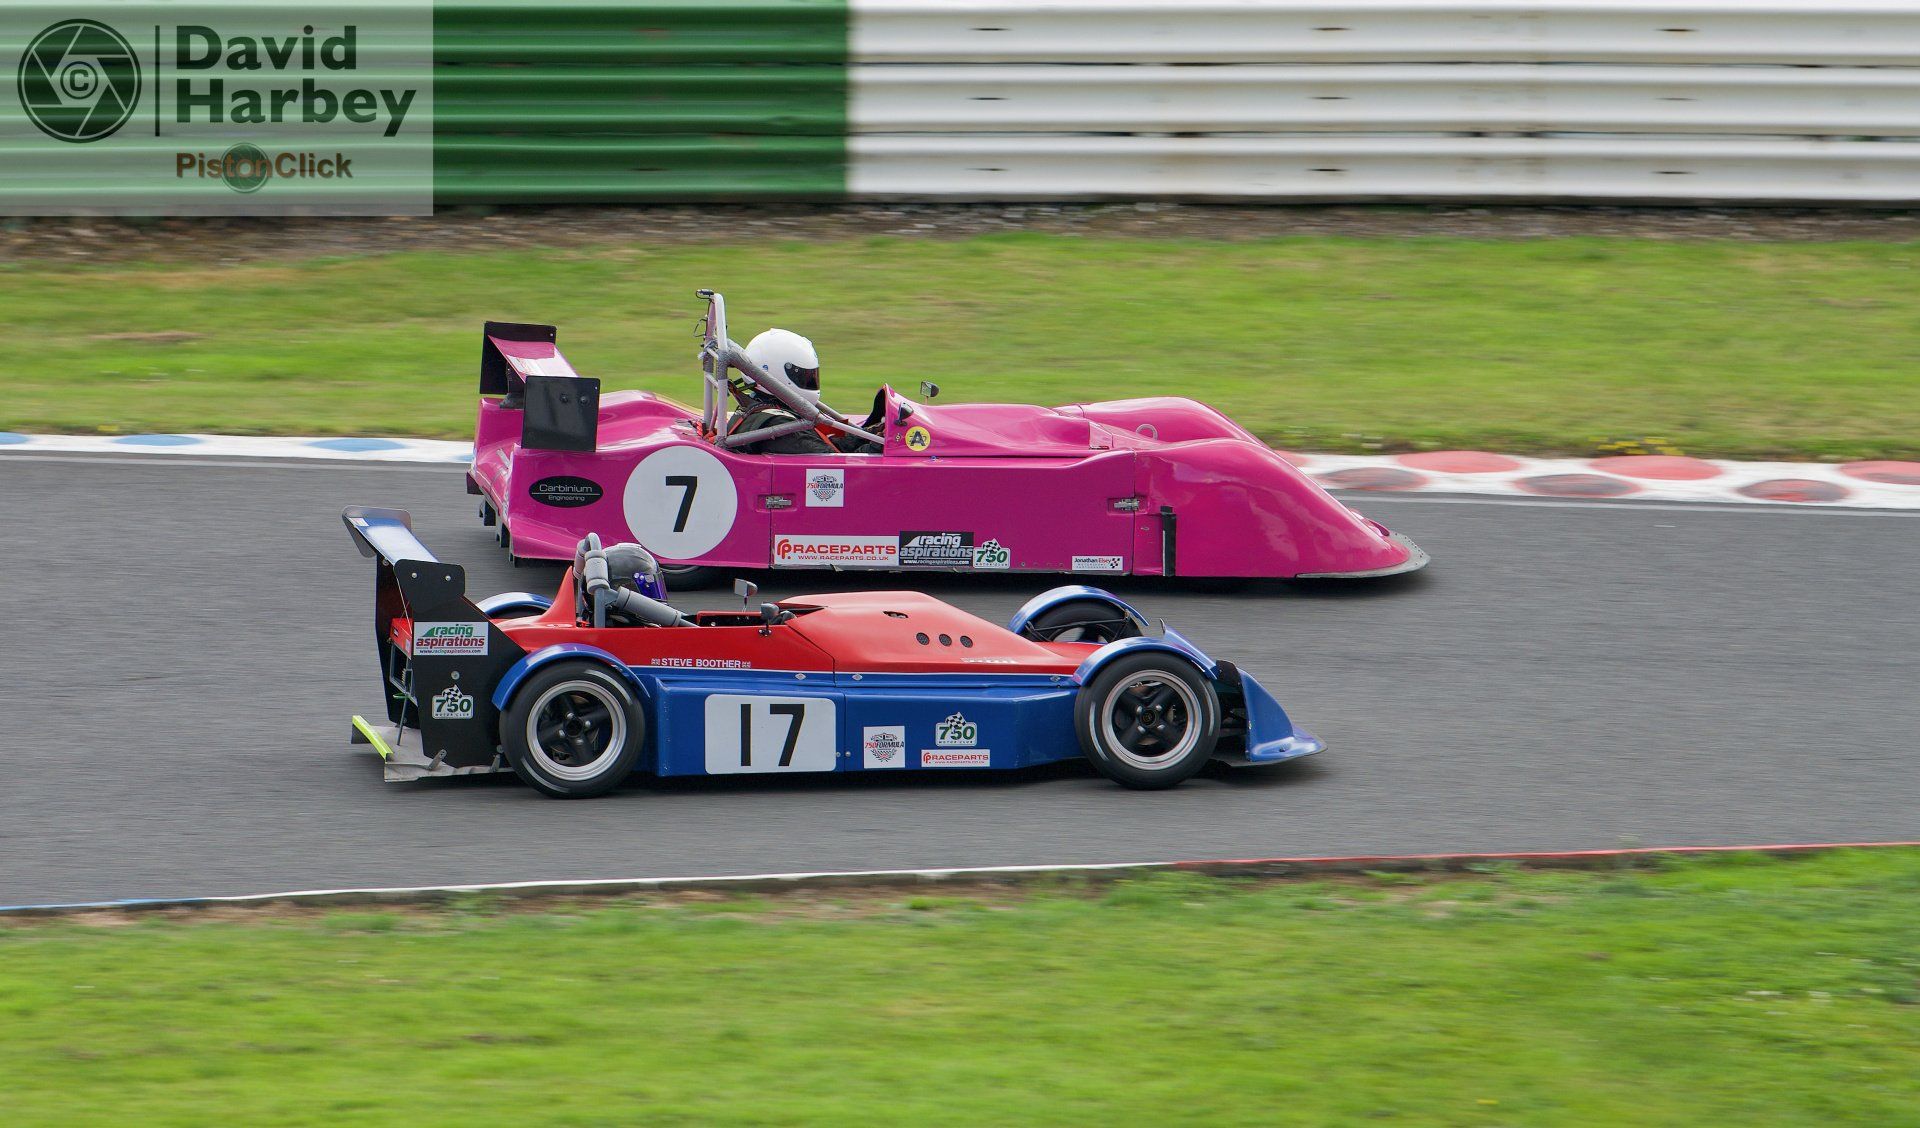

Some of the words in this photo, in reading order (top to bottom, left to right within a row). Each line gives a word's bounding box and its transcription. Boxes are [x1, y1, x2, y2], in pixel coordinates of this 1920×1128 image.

[539, 483, 593, 493] Carbinium
[665, 475, 698, 533] 7
[919, 533, 962, 548] racing
[793, 544, 897, 555] RACEPARTS
[900, 545, 974, 560] aspirations
[976, 550, 1008, 563] 750
[435, 624, 474, 637] racing
[416, 635, 485, 649] aspirations
[661, 658, 693, 667] STEVE
[695, 659, 741, 668] BOOTHER
[435, 698, 472, 713] 750
[740, 703, 805, 767] 17
[938, 726, 975, 740] 750
